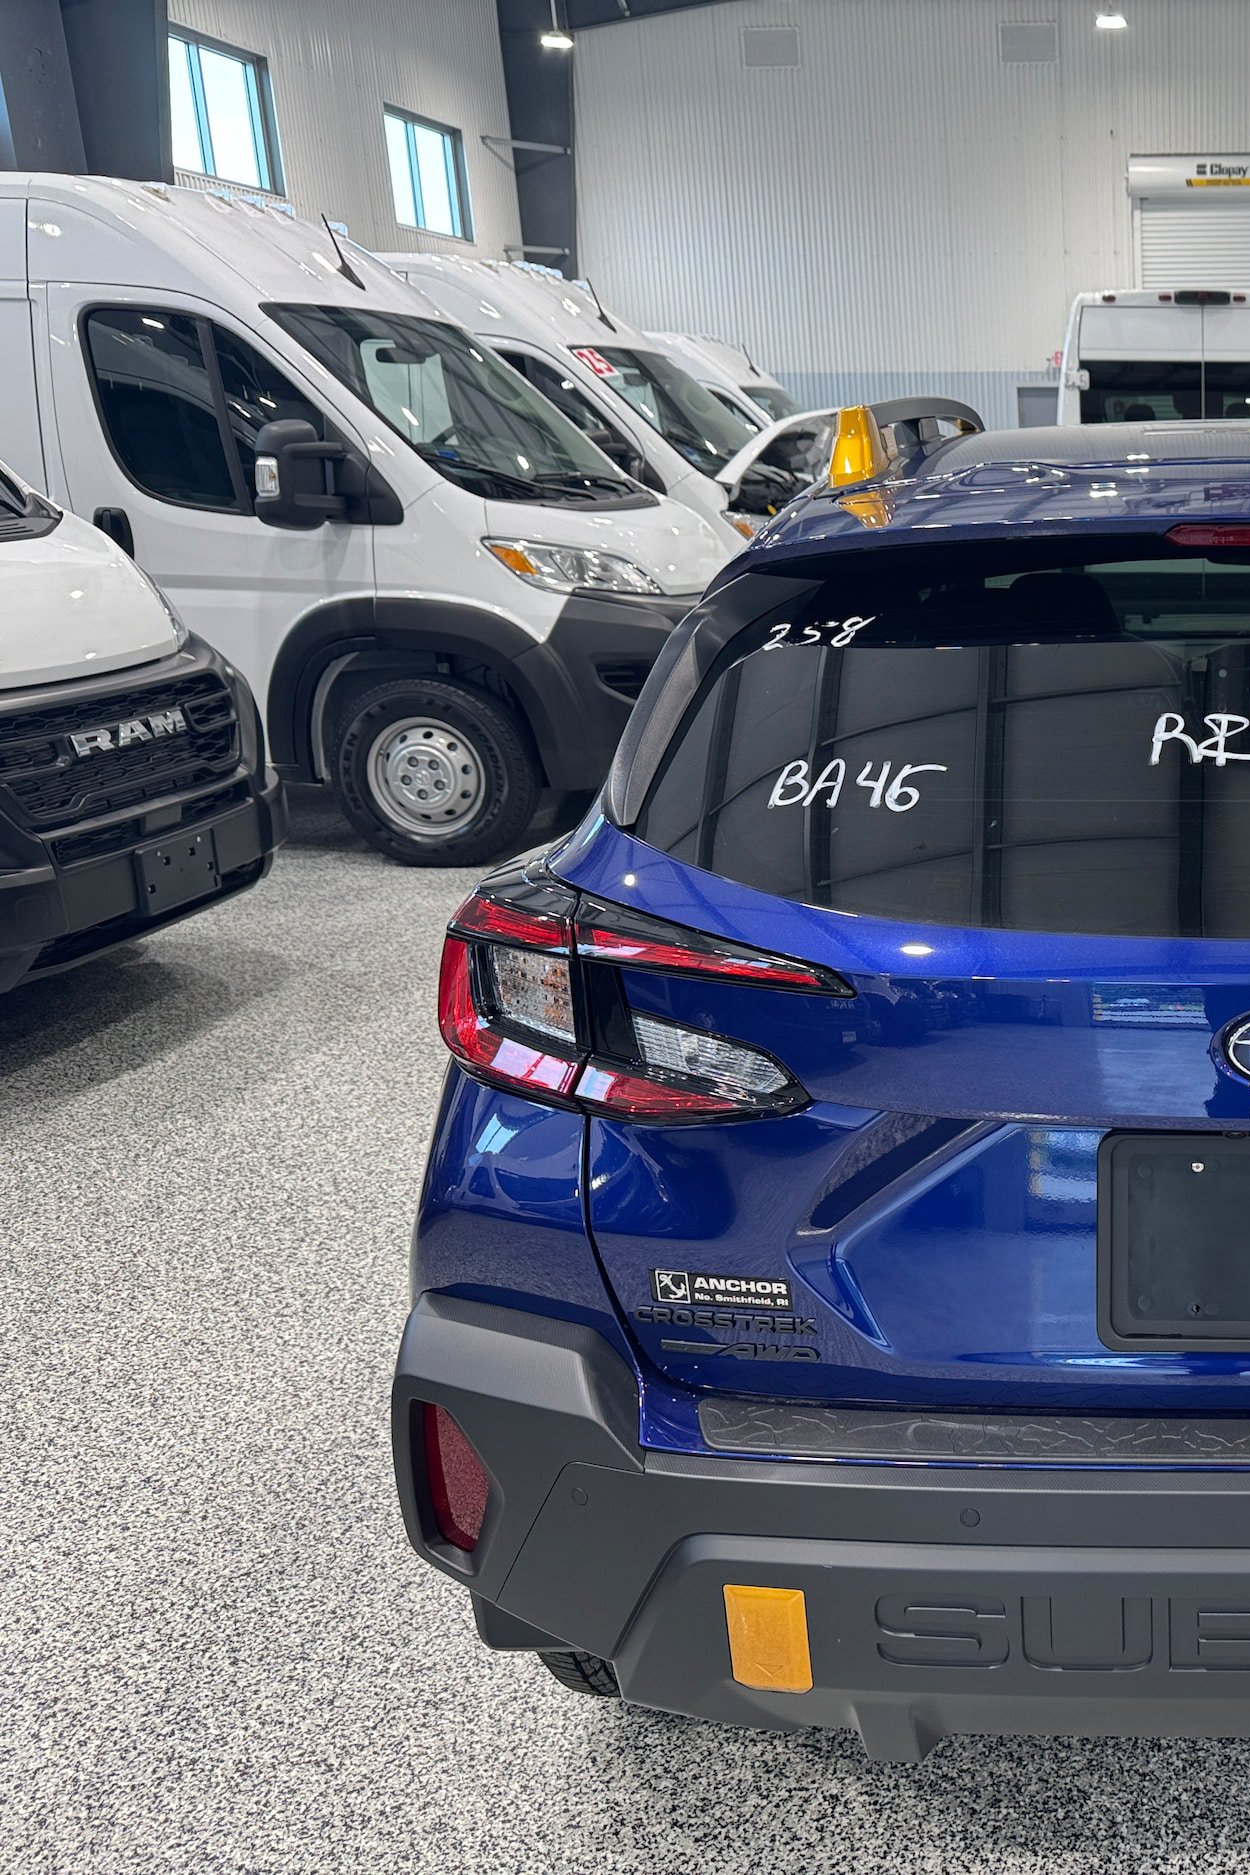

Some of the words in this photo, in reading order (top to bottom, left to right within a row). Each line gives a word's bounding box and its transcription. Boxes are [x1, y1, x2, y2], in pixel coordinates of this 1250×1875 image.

[1210, 163, 1249, 178] Clopay
[69, 709, 189, 757] RAM
[694, 1277, 788, 1294] ANCHOR
[695, 1292, 714, 1301] No.
[715, 1294, 774, 1306] Smithfield,
[776, 1298, 789, 1306] RI
[634, 1306, 818, 1336] CROSSTREK
[716, 1342, 821, 1362] AWD
